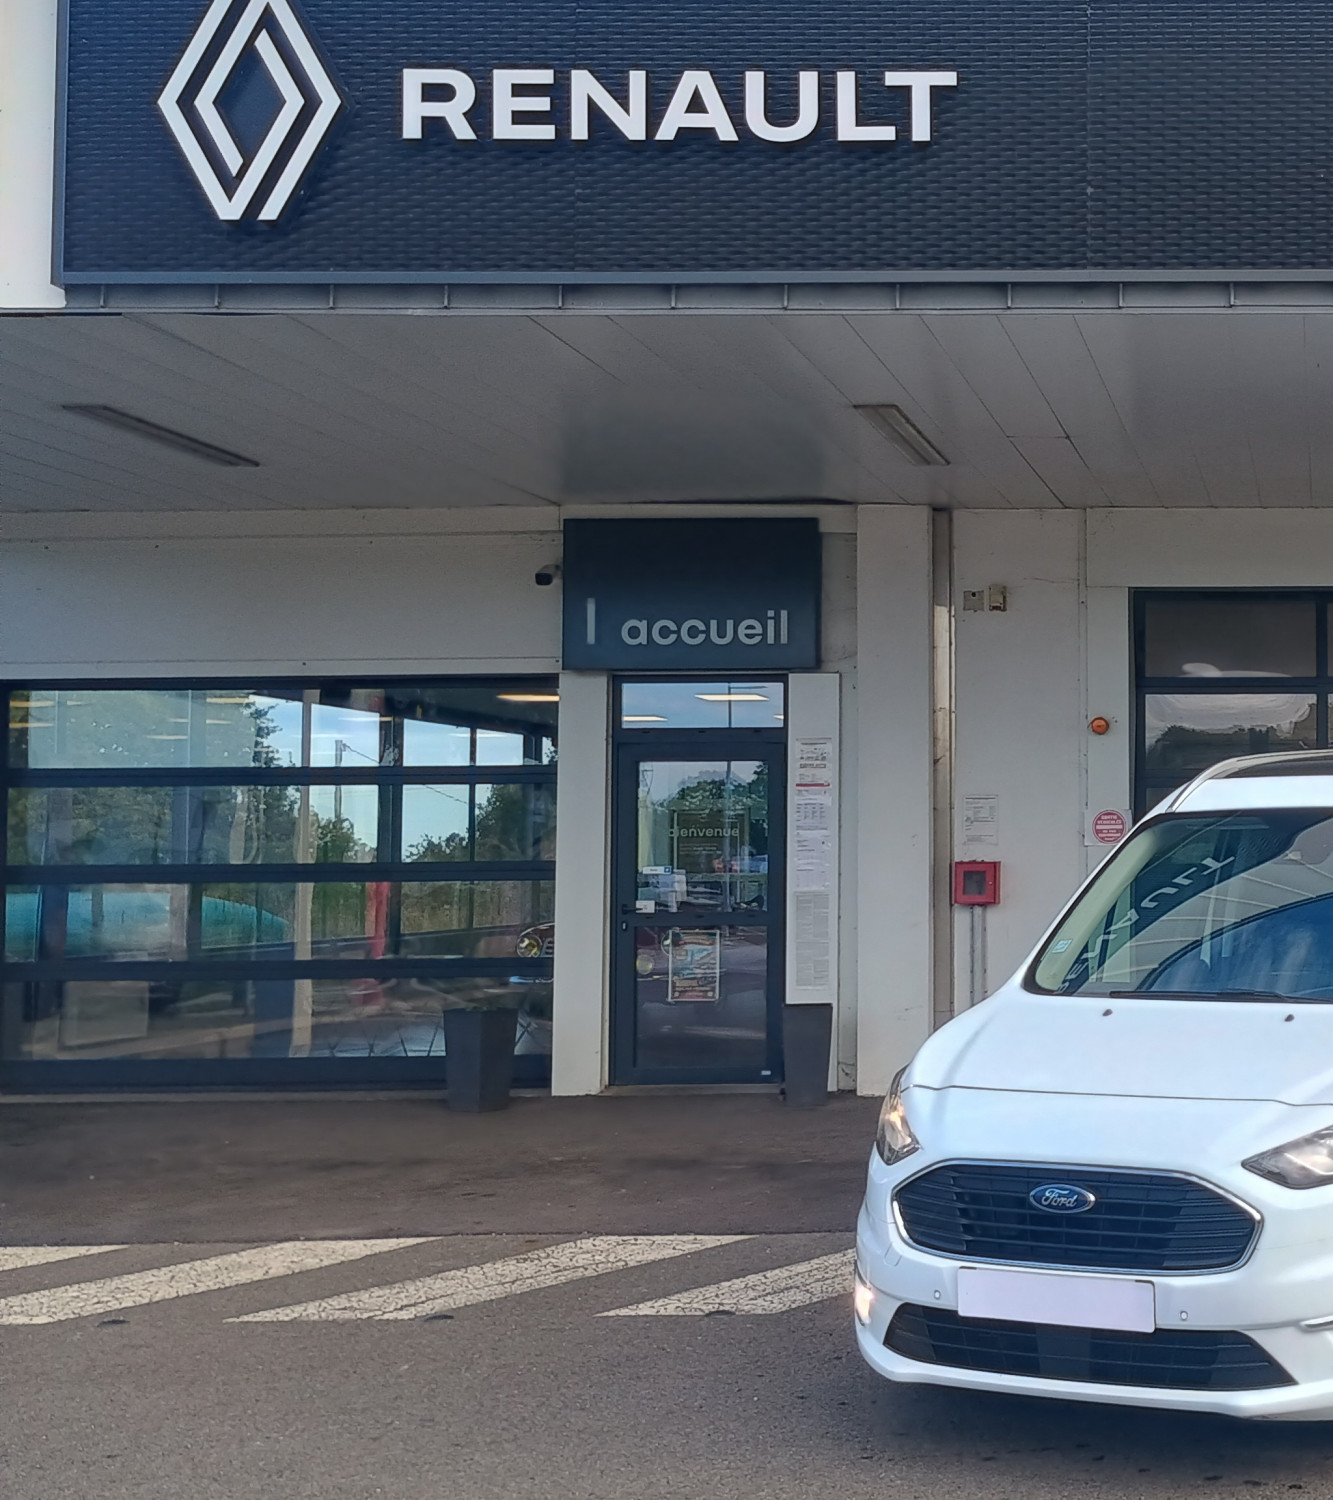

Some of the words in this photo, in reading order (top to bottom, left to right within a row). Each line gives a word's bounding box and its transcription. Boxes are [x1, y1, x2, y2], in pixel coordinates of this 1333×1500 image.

[401, 68, 958, 142] RENAULT
[621, 609, 788, 646] accueil
[1041, 1188, 1079, 1208] Ford
